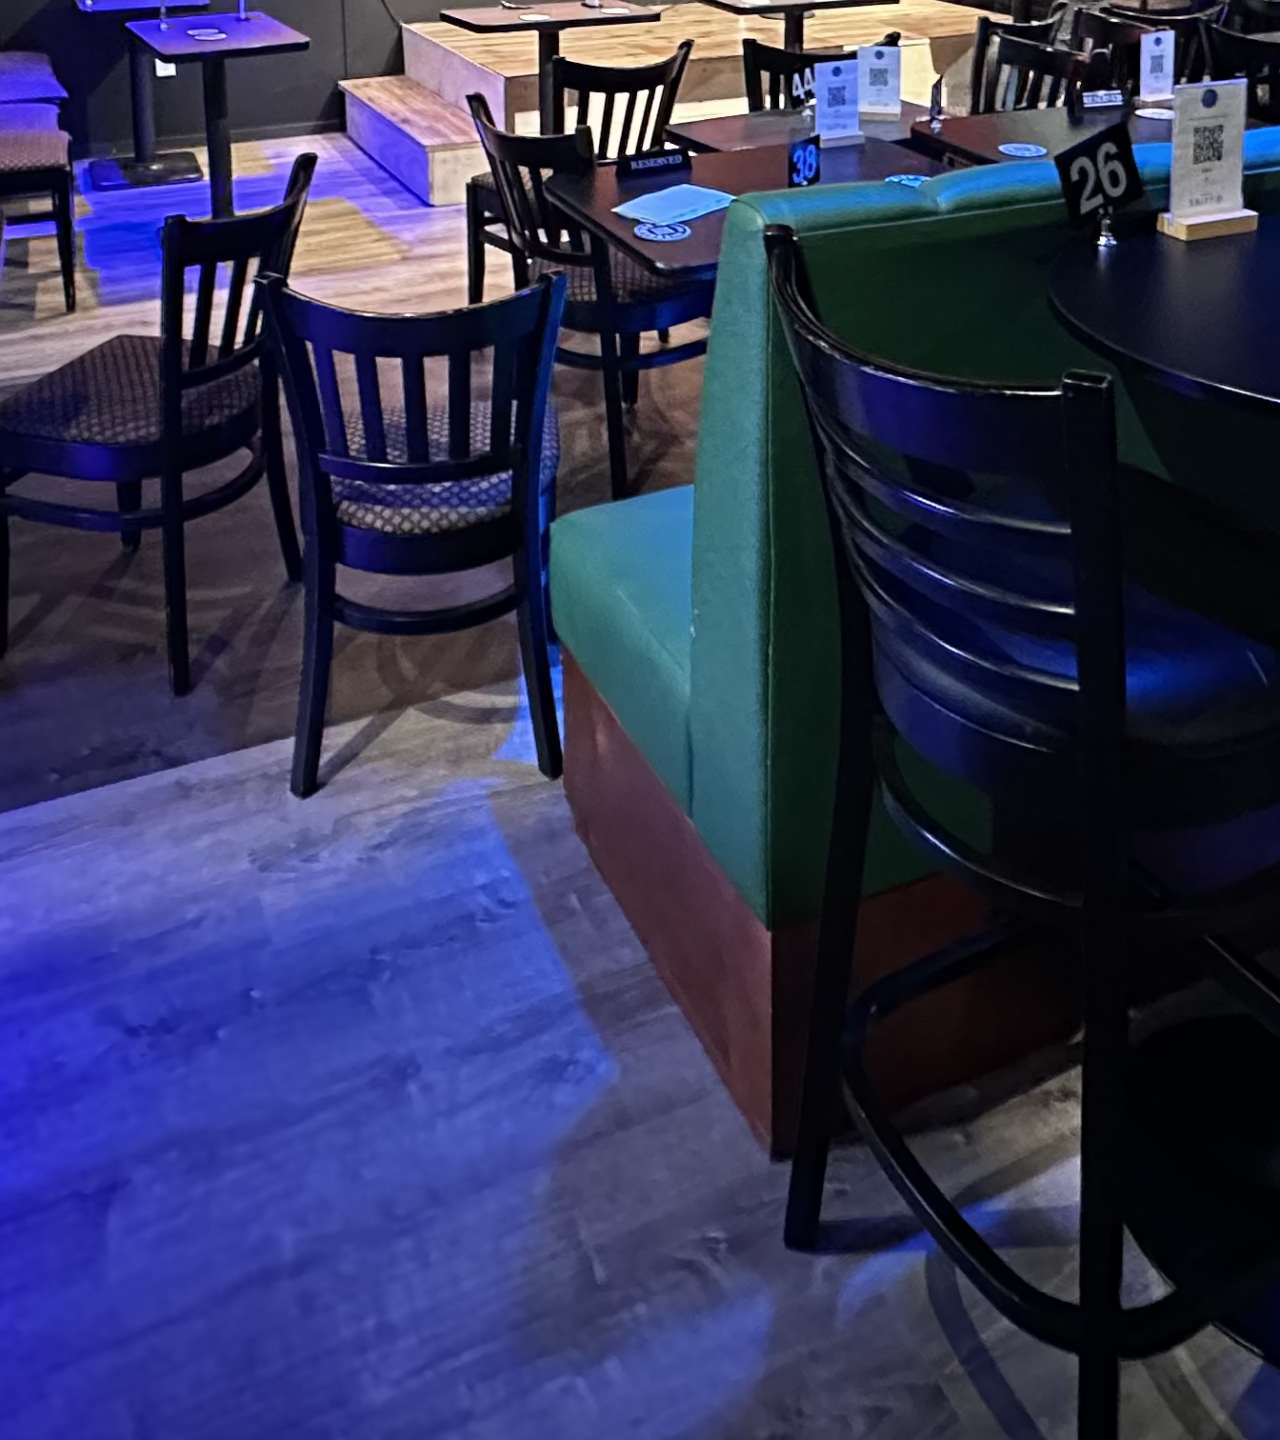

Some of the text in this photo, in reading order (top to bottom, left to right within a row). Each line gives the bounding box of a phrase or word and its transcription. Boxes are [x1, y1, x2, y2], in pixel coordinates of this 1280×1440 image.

[630, 154, 683, 170] RESERVED
[792, 144, 818, 184] 38
[1070, 142, 1128, 216] 26
